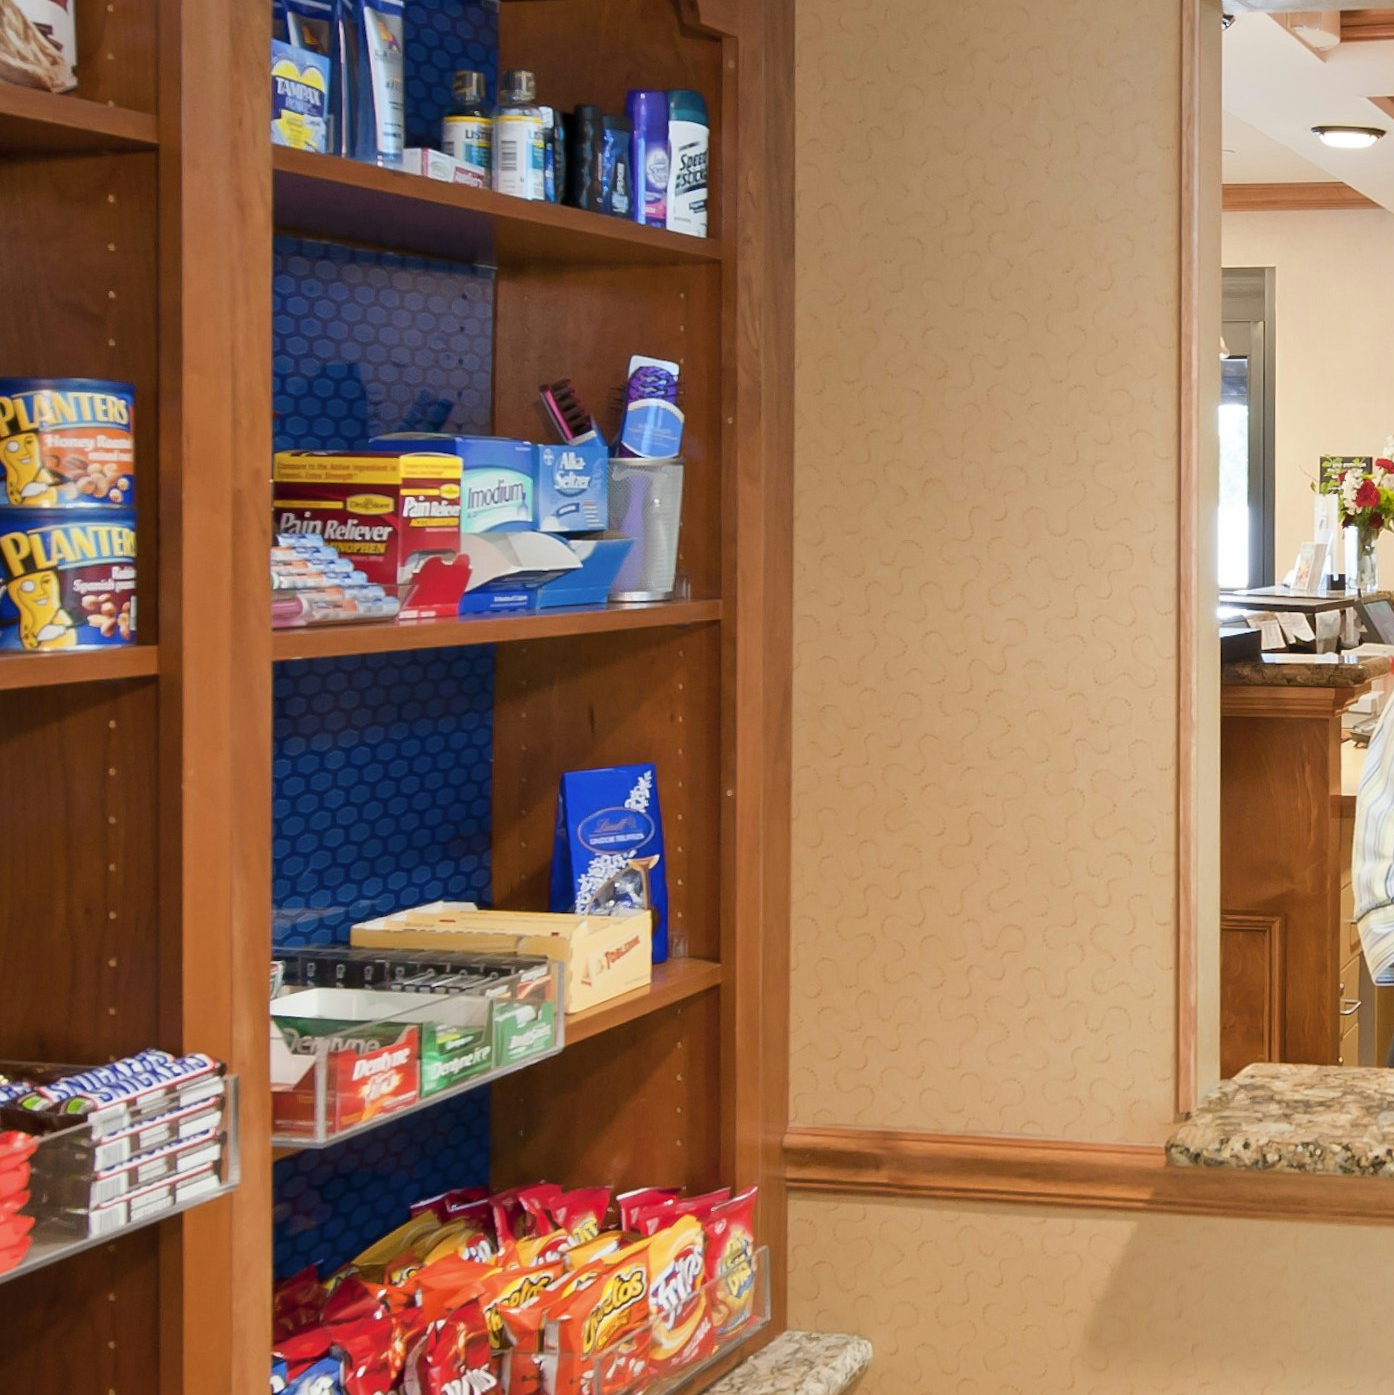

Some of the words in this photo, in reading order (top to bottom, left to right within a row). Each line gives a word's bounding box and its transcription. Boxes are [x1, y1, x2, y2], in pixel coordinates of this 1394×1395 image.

[0, 391, 129, 438] PLANTERS
[403, 495, 431, 518] Pain
[467, 479, 525, 510] Imodium
[279, 511, 323, 536] Pain
[324, 519, 394, 542] Reliever
[98, 1055, 207, 1104] SNICKERS
[351, 1047, 412, 1082] Dentyne
[650, 1243, 703, 1332] Fritos
